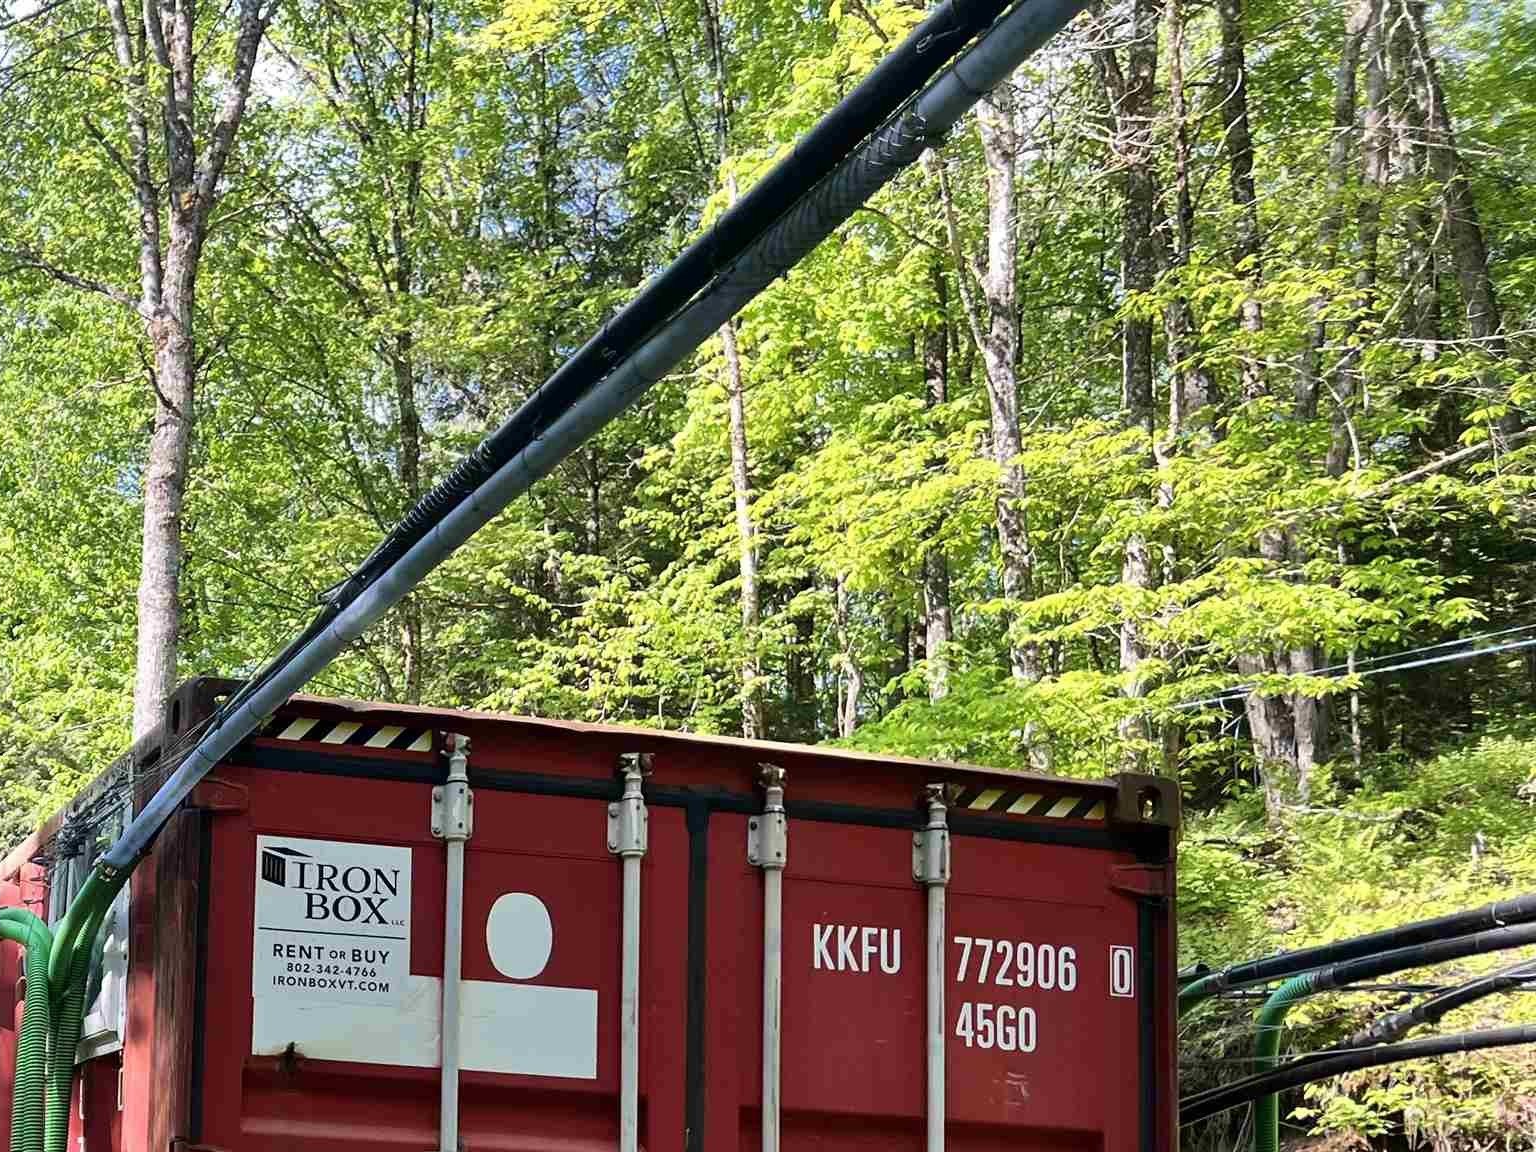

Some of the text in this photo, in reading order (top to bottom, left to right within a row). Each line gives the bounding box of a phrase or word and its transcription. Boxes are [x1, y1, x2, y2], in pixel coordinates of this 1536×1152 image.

[290, 861, 400, 896] IRON
[304, 892, 389, 925] BOX
[273, 943, 390, 964] RENT OR BUY
[813, 923, 902, 974] KKFU
[953, 936, 1077, 992] 772906
[272, 975, 390, 992] IRONBOXVT.COM
[286, 962, 377, 978] 802-342-4766
